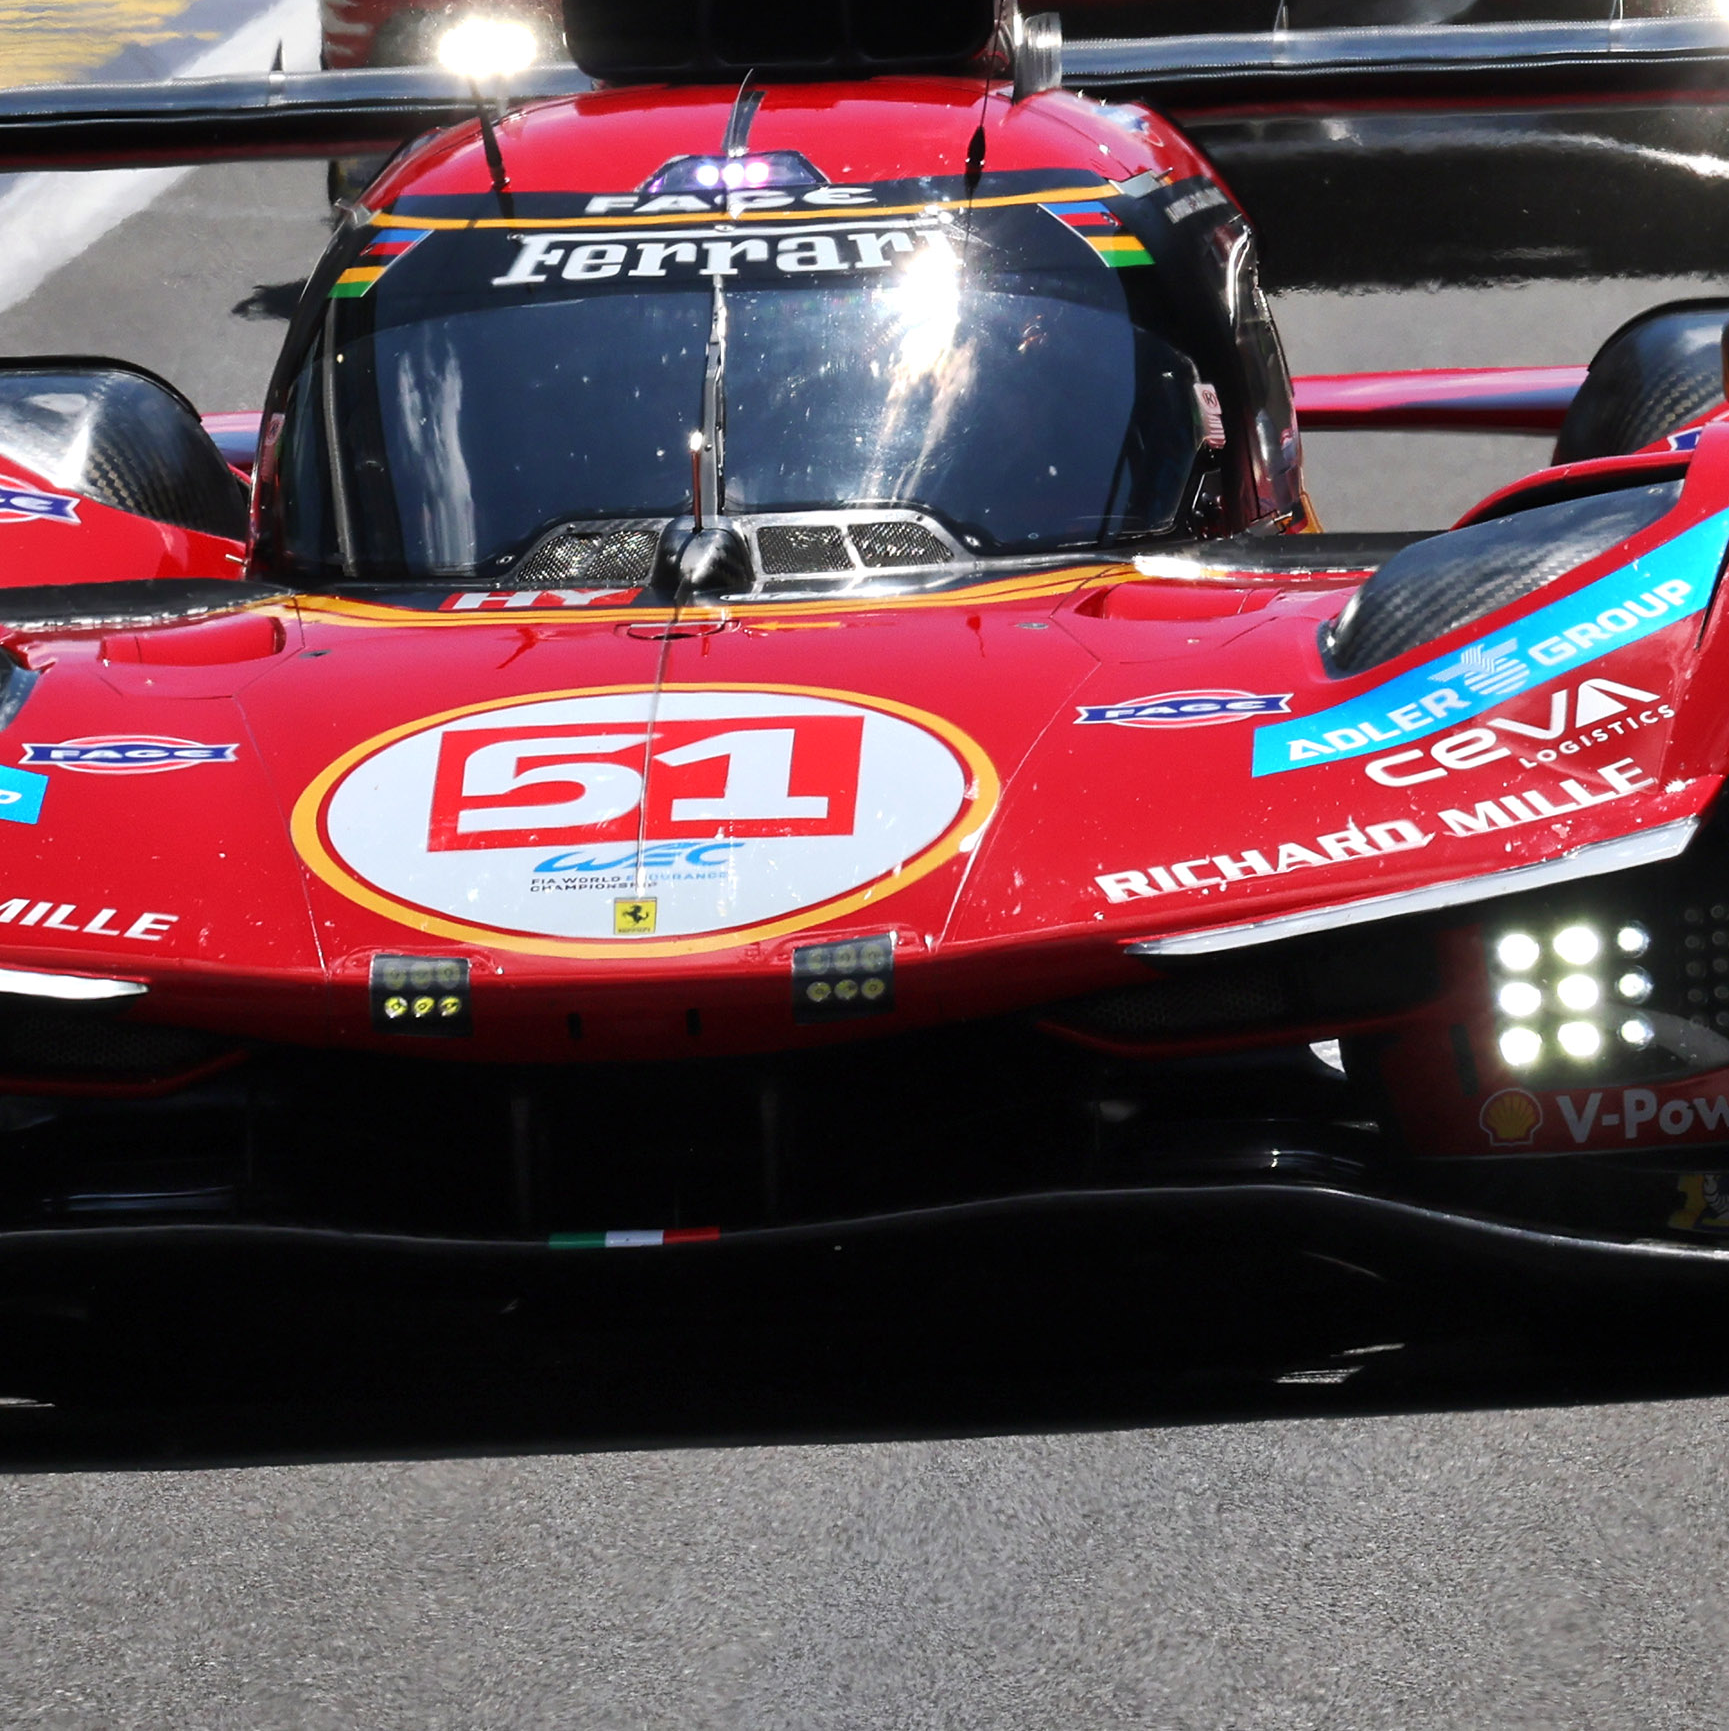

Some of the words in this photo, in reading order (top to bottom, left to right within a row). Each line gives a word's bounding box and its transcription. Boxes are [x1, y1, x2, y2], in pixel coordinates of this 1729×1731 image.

[451, 588, 611, 611] HY
[1284, 686, 1474, 764] ADLER
[1529, 575, 1693, 668] GROUP
[1517, 701, 1676, 773] LOGISTICS
[456, 727, 832, 836] 51
[532, 841, 747, 874] WEC
[1094, 816, 1436, 905] RICHARD
[1436, 756, 1658, 840] MILLE
[530, 877, 557, 886] FIA
[561, 875, 621, 884] WORLD
